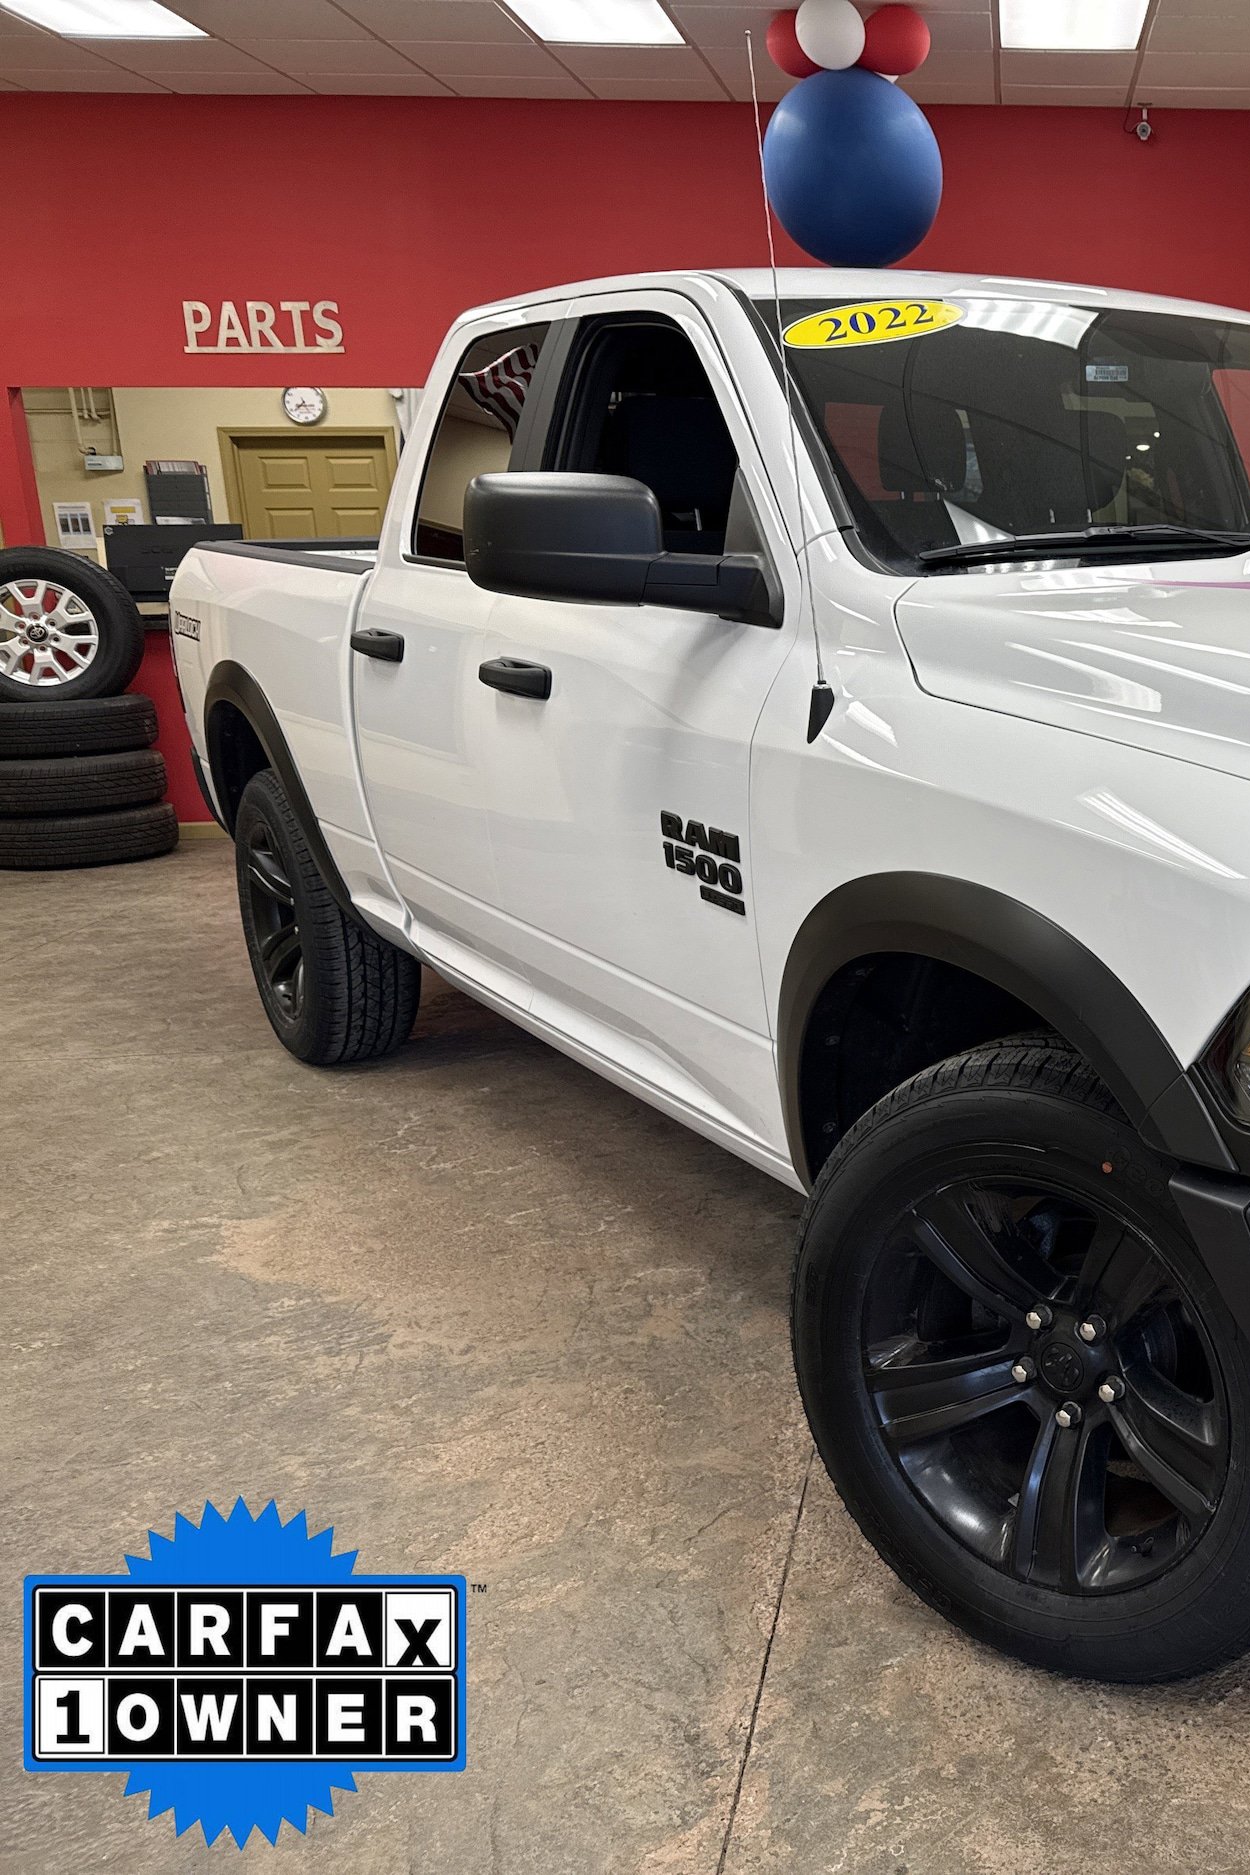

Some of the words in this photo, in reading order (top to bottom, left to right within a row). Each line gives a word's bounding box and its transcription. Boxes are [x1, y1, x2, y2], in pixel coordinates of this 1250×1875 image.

[182, 300, 344, 351] PARTS
[819, 304, 934, 342] 2022
[660, 810, 741, 863] RAM
[663, 841, 743, 895] 1500
